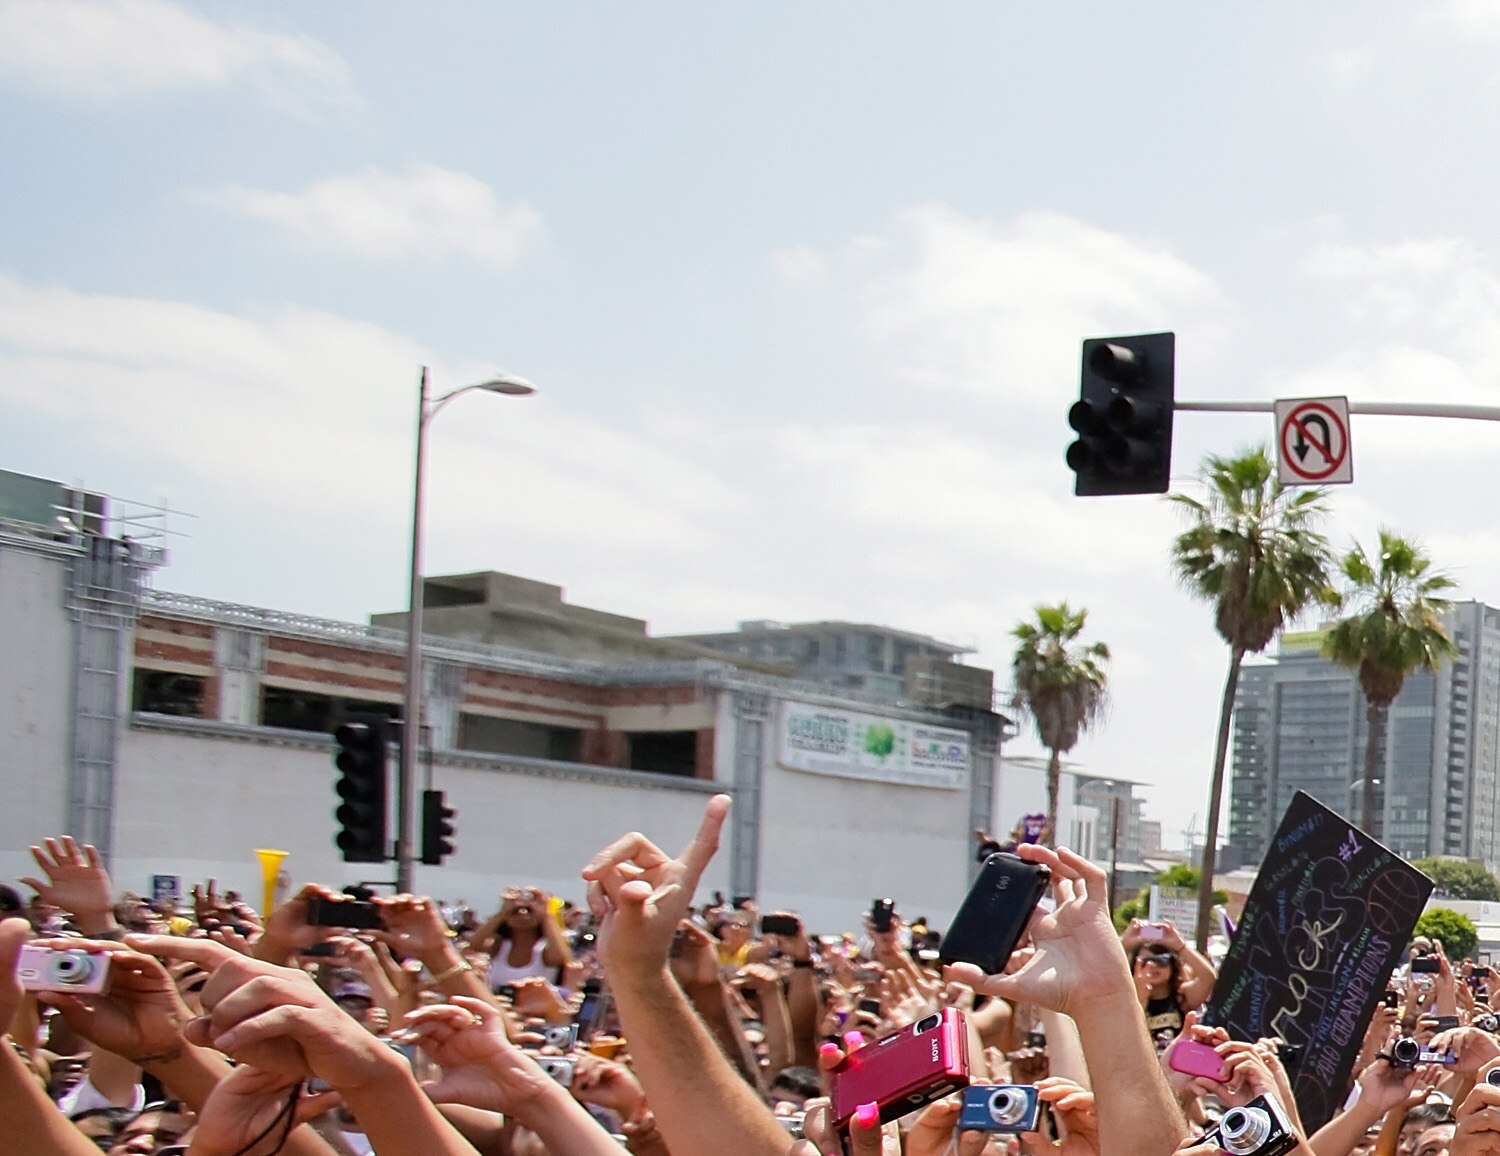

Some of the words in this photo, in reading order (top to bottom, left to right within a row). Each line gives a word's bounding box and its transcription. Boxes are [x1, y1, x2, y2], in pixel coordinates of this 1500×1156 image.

[1338, 829, 1364, 862] #1
[1328, 934, 1392, 1047] CHAMPIONS
[931, 1038, 939, 1062] SONY
